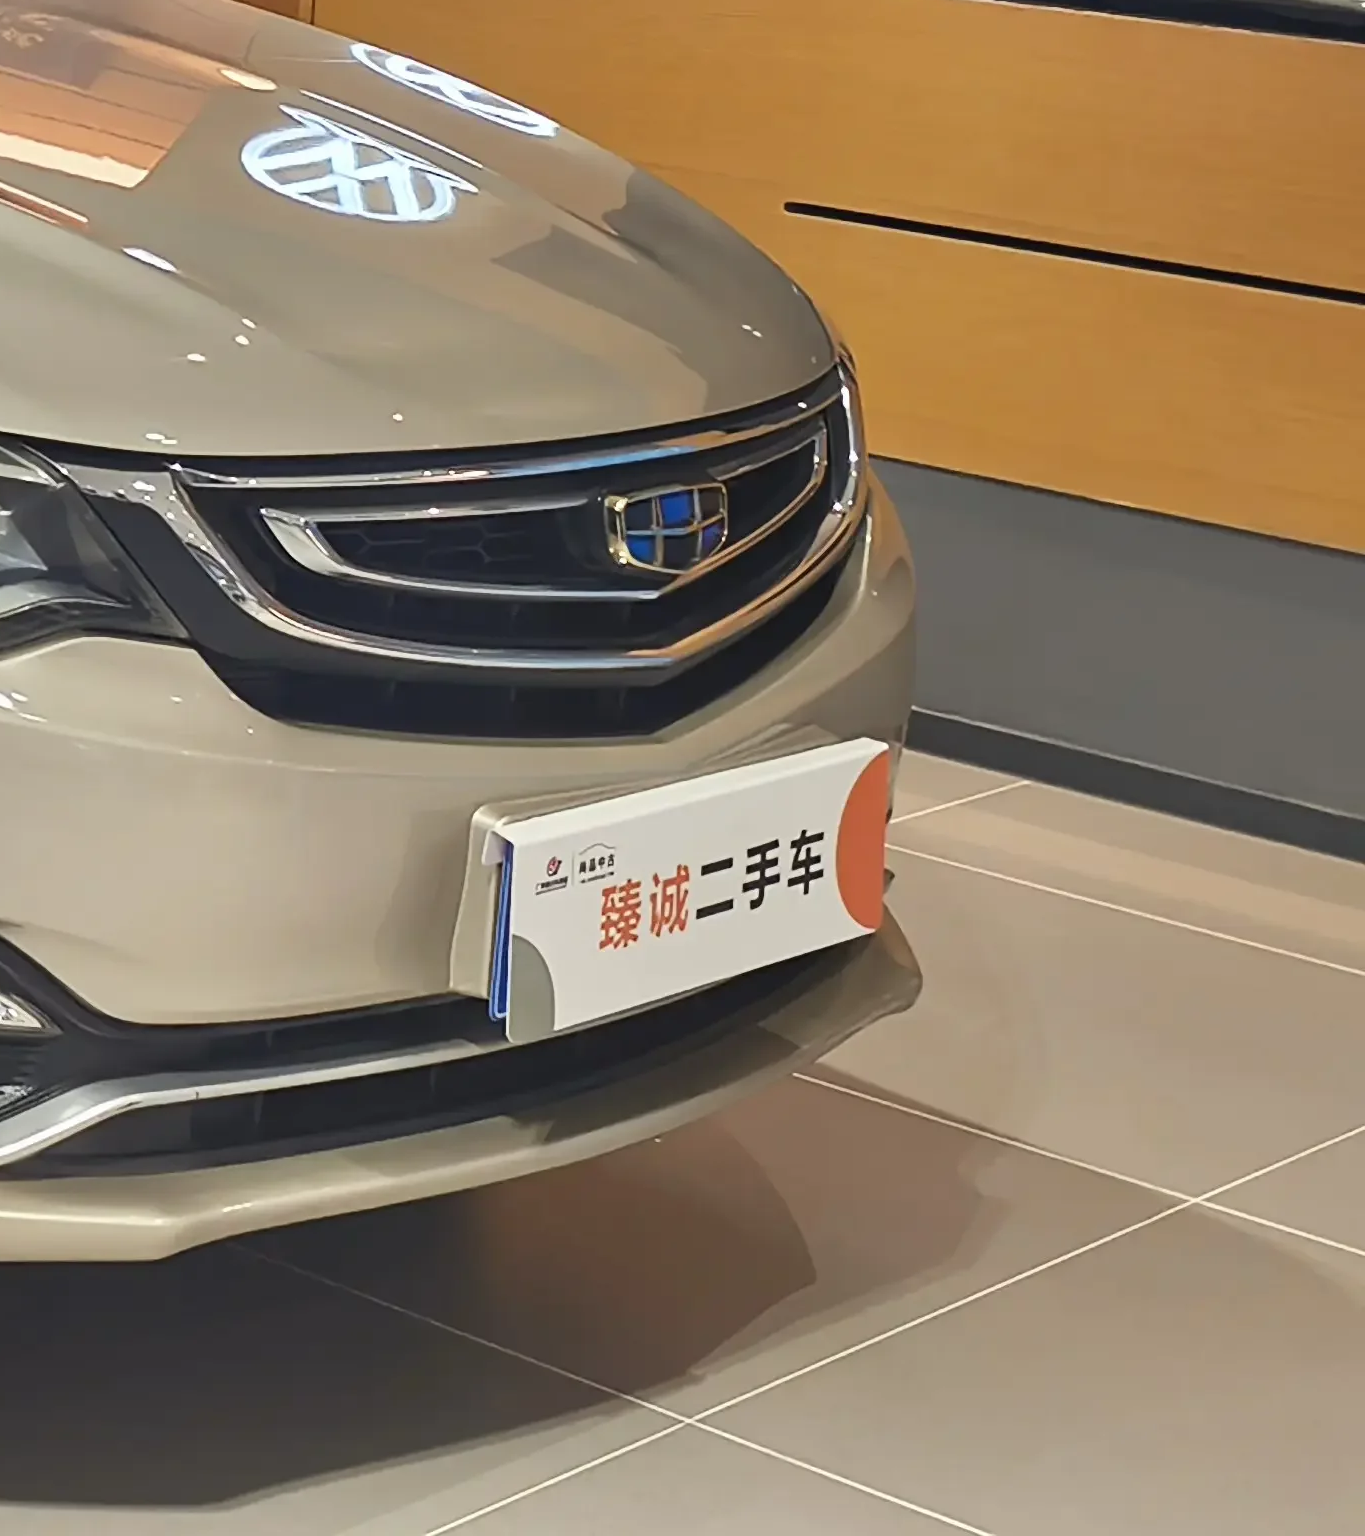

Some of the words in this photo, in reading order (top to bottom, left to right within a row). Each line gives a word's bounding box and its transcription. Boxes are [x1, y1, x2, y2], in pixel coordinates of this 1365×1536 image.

[598, 829, 825, 950] 臻诚二手车
